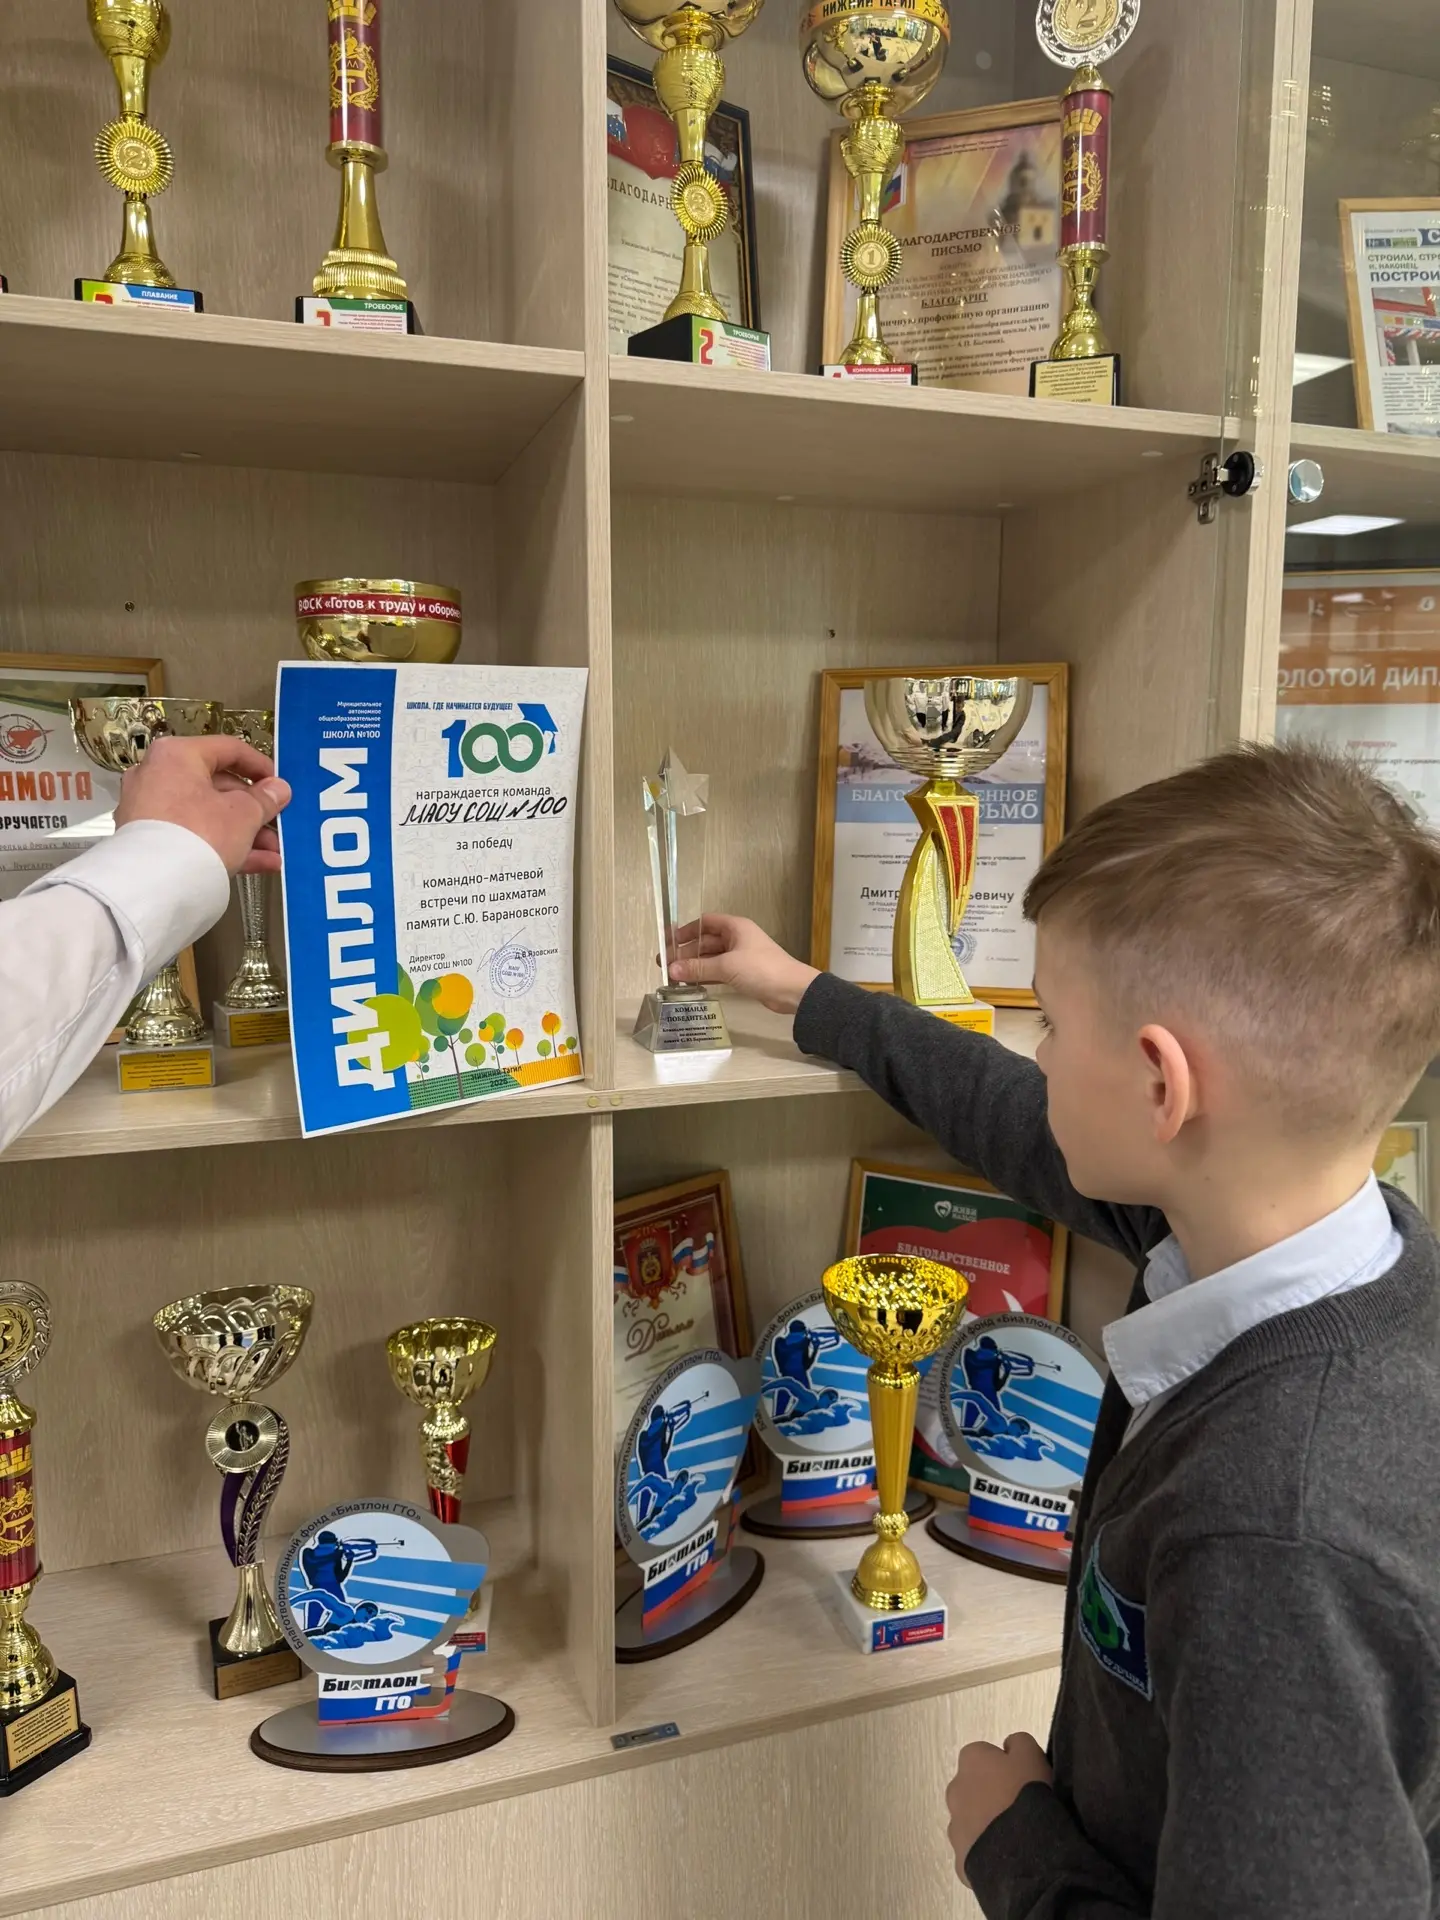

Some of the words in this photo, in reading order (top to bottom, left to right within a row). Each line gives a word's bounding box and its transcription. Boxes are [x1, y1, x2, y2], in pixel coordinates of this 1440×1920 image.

[931, 243, 982, 257] ПИСЬМО
[141, 290, 178, 301] ПЛАВАНИЕ
[364, 302, 404, 311] ТРОЕБОРЬЕ
[700, 328, 713, 365] 2
[325, 596, 364, 609] «Готов
[368, 600, 376, 609] к
[379, 599, 416, 615] труду
[418, 603, 426, 612] и
[1383, 666, 1440, 691] ДИП
[432, 702, 444, 710] ГДЕ
[445, 701, 482, 710] НАЧИНАЕТСЯ
[483, 702, 513, 711] БУДУЩЕЕ!
[323, 731, 355, 739] ШКОЛА
[356, 730, 381, 738] №100
[416, 788, 499, 802] награждается
[502, 786, 551, 798] команда
[399, 802, 463, 826] МАОУ
[463, 801, 508, 823] СОШ
[456, 841, 469, 850] за
[472, 837, 513, 850] победу
[423, 867, 544, 889] командно-матчевой
[420, 895, 468, 910] встречи
[471, 893, 486, 904] по
[489, 888, 547, 902] шахматам
[318, 747, 396, 1091] ДИПЛОМ
[406, 916, 450, 931] памяти
[453, 912, 479, 926] С.Ю.
[482, 905, 559, 923] Барановского
[409, 953, 446, 965] Директор
[409, 963, 432, 974] МАОУ
[433, 961, 451, 971] СОШ
[452, 958, 473, 969] №100
[667, 1013, 717, 1022] ПОБЕДИТЕЛЕЙ
[674, 1005, 708, 1013] КОМАНДЕ
[502, 1065, 523, 1074] Тагил
[897, 1242, 1011, 1275] БЛАГОДАРСТВЕННОЕ
[967, 1317, 996, 1335] фонд
[639, 1383, 663, 1418] фонд
[835, 1473, 868, 1489] ГТО
[1024, 1511, 1060, 1531] ГТО
[684, 1547, 709, 1577] ГТО
[277, 1538, 304, 1650] Благотворительный
[300, 1513, 330, 1538] фонд
[330, 1501, 390, 1519] «Биатлон
[374, 1694, 412, 1711] ГТО
